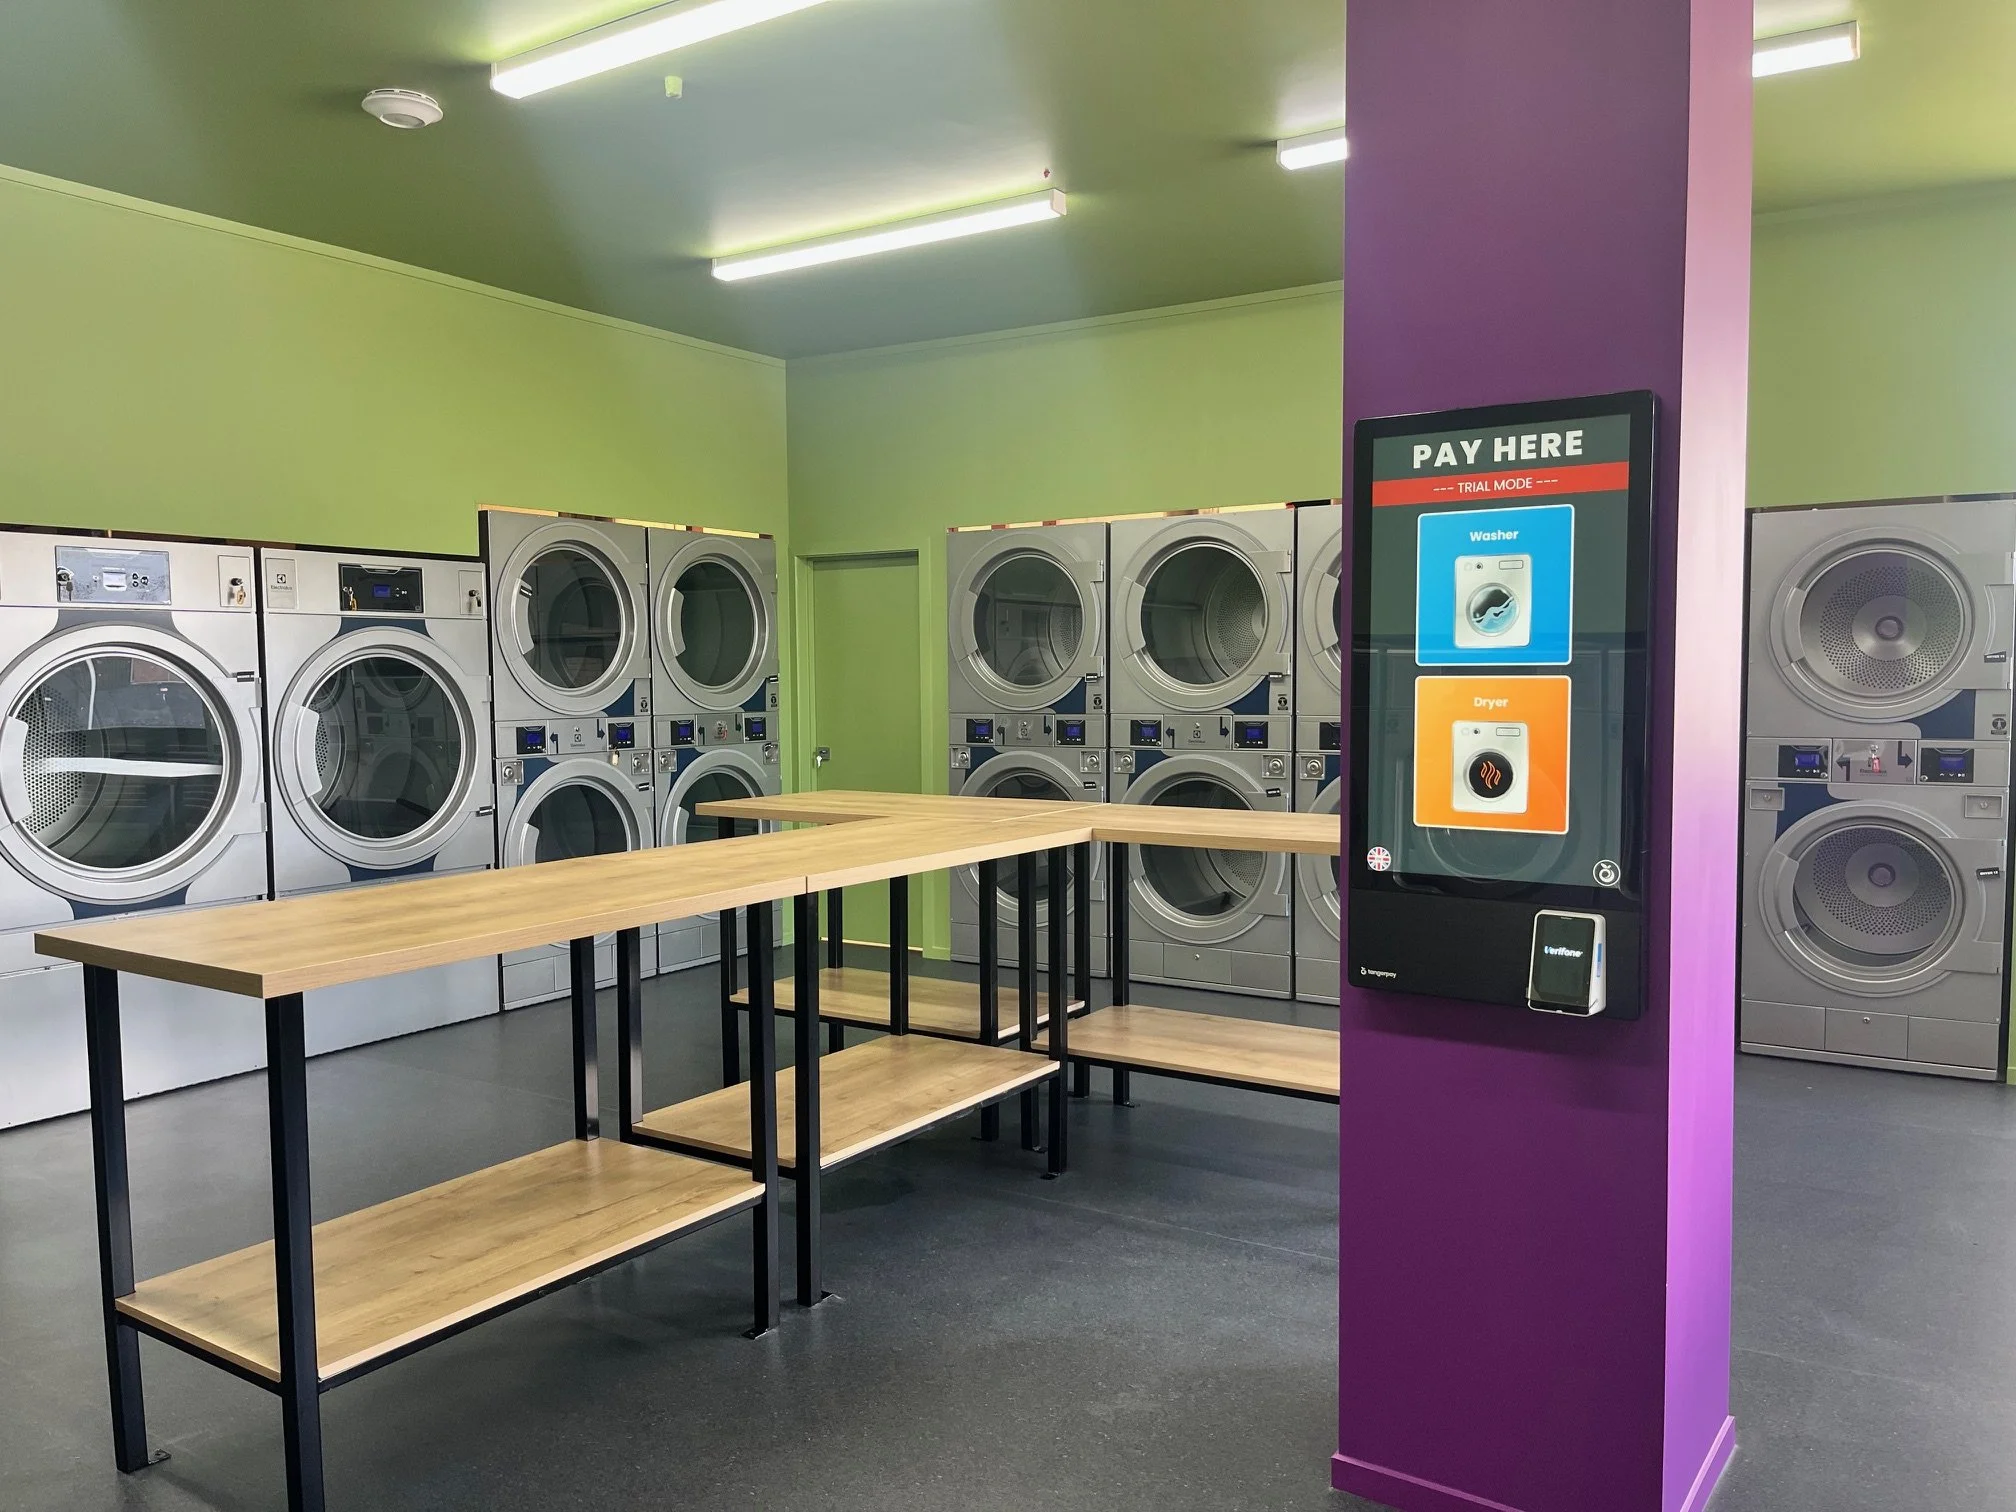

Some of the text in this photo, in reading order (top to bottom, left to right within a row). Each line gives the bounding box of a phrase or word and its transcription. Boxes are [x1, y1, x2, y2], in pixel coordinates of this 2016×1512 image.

[1413, 430, 1583, 469] PAY HERE
[1457, 481, 1491, 494] TRIAL
[1494, 477, 1533, 491] MODE
[1469, 529, 1519, 542] Washer
[1473, 696, 1509, 711] Dryer
[1544, 945, 1583, 958] Verifone
